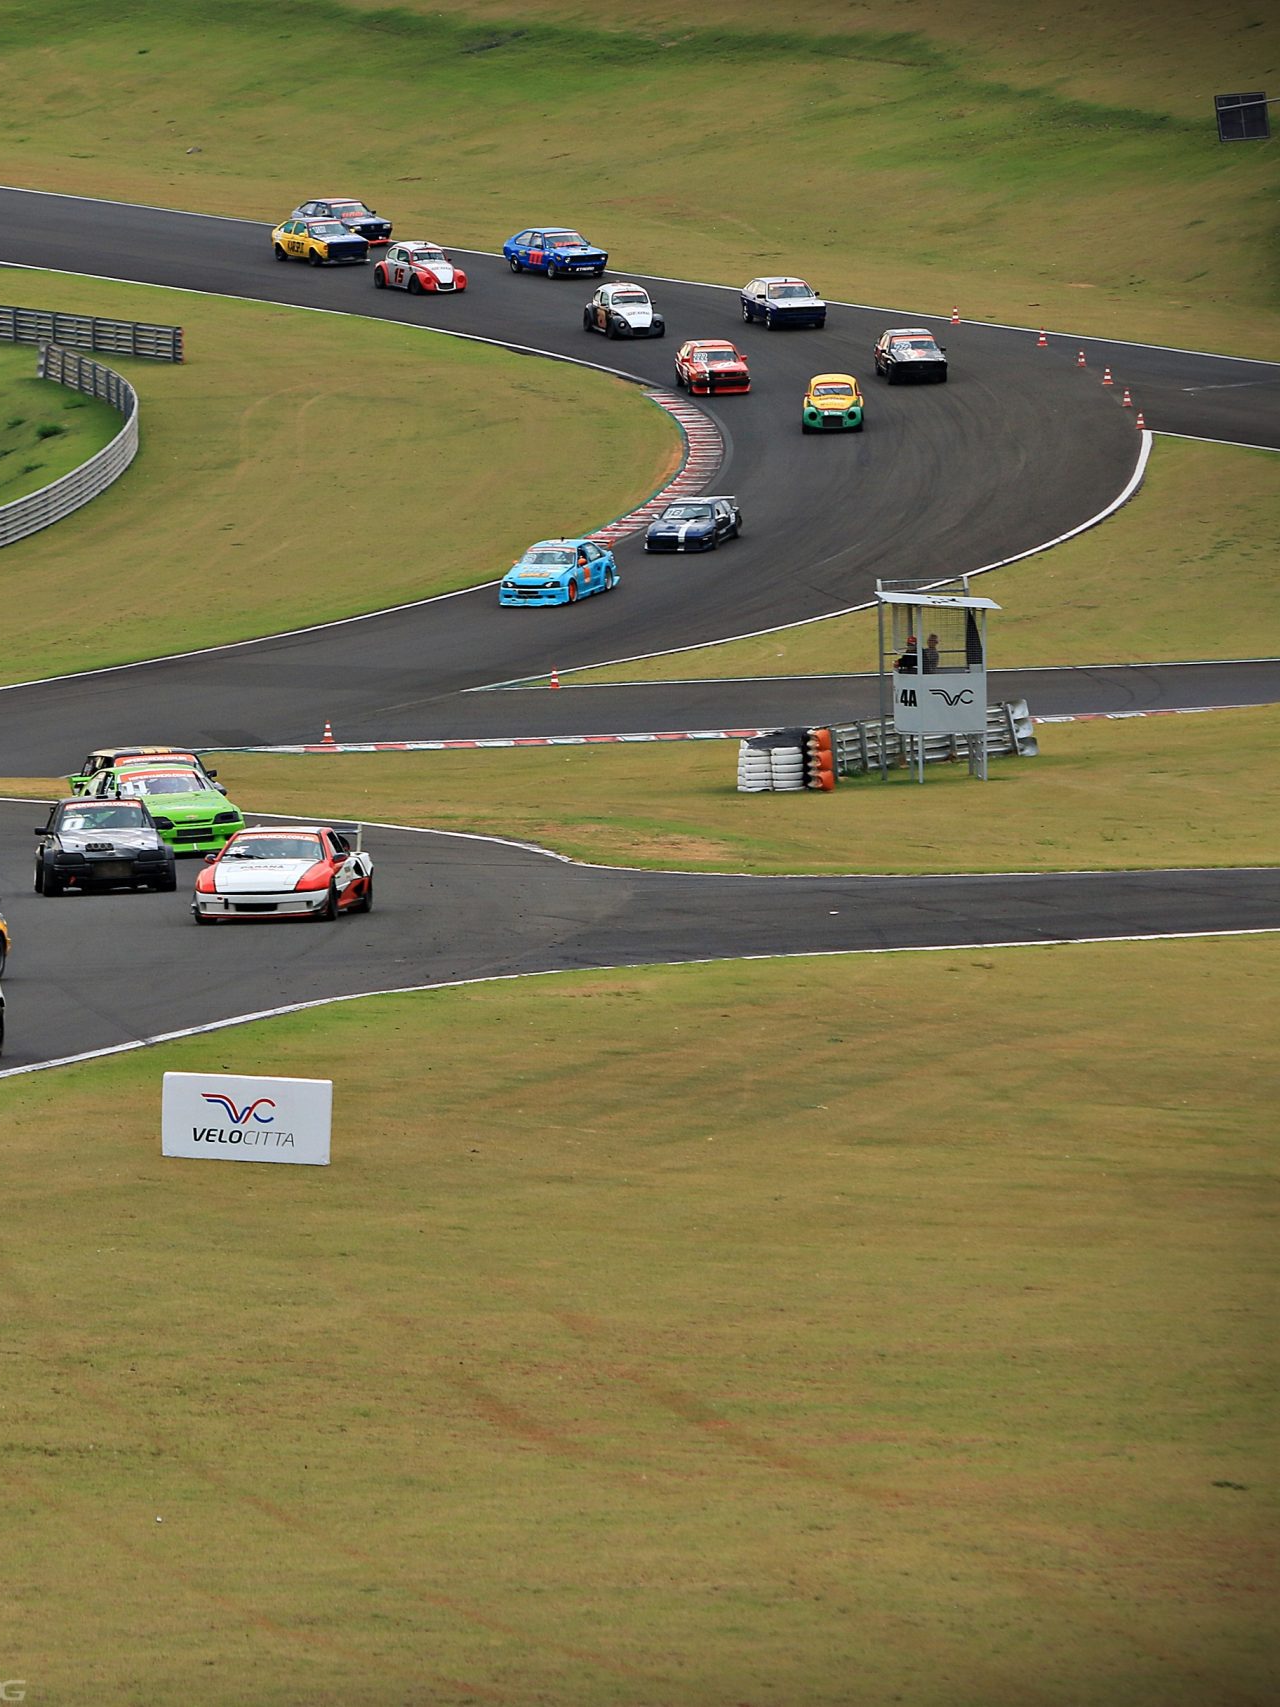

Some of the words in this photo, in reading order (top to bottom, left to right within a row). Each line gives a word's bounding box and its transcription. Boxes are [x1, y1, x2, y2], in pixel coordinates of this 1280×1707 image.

[395, 268, 405, 283] 15
[900, 689, 917, 706] 4A
[192, 1128, 294, 1147] VELOCITTA
